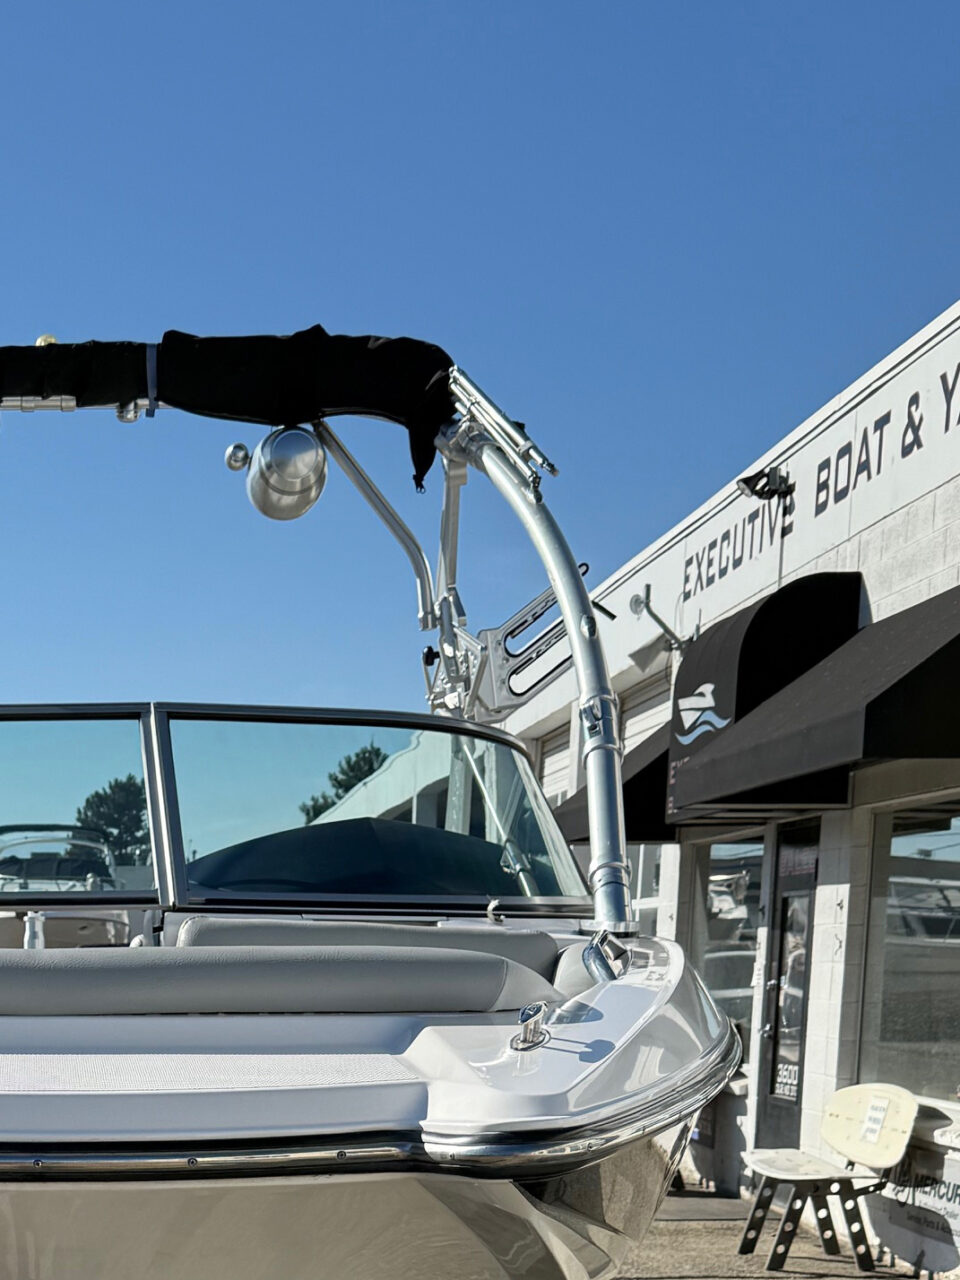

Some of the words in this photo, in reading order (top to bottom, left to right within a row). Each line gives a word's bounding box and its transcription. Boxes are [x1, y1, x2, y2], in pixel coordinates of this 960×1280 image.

[815, 409, 891, 518] BOAT
[901, 391, 923, 459] &
[777, 1063, 799, 1085] 3600
